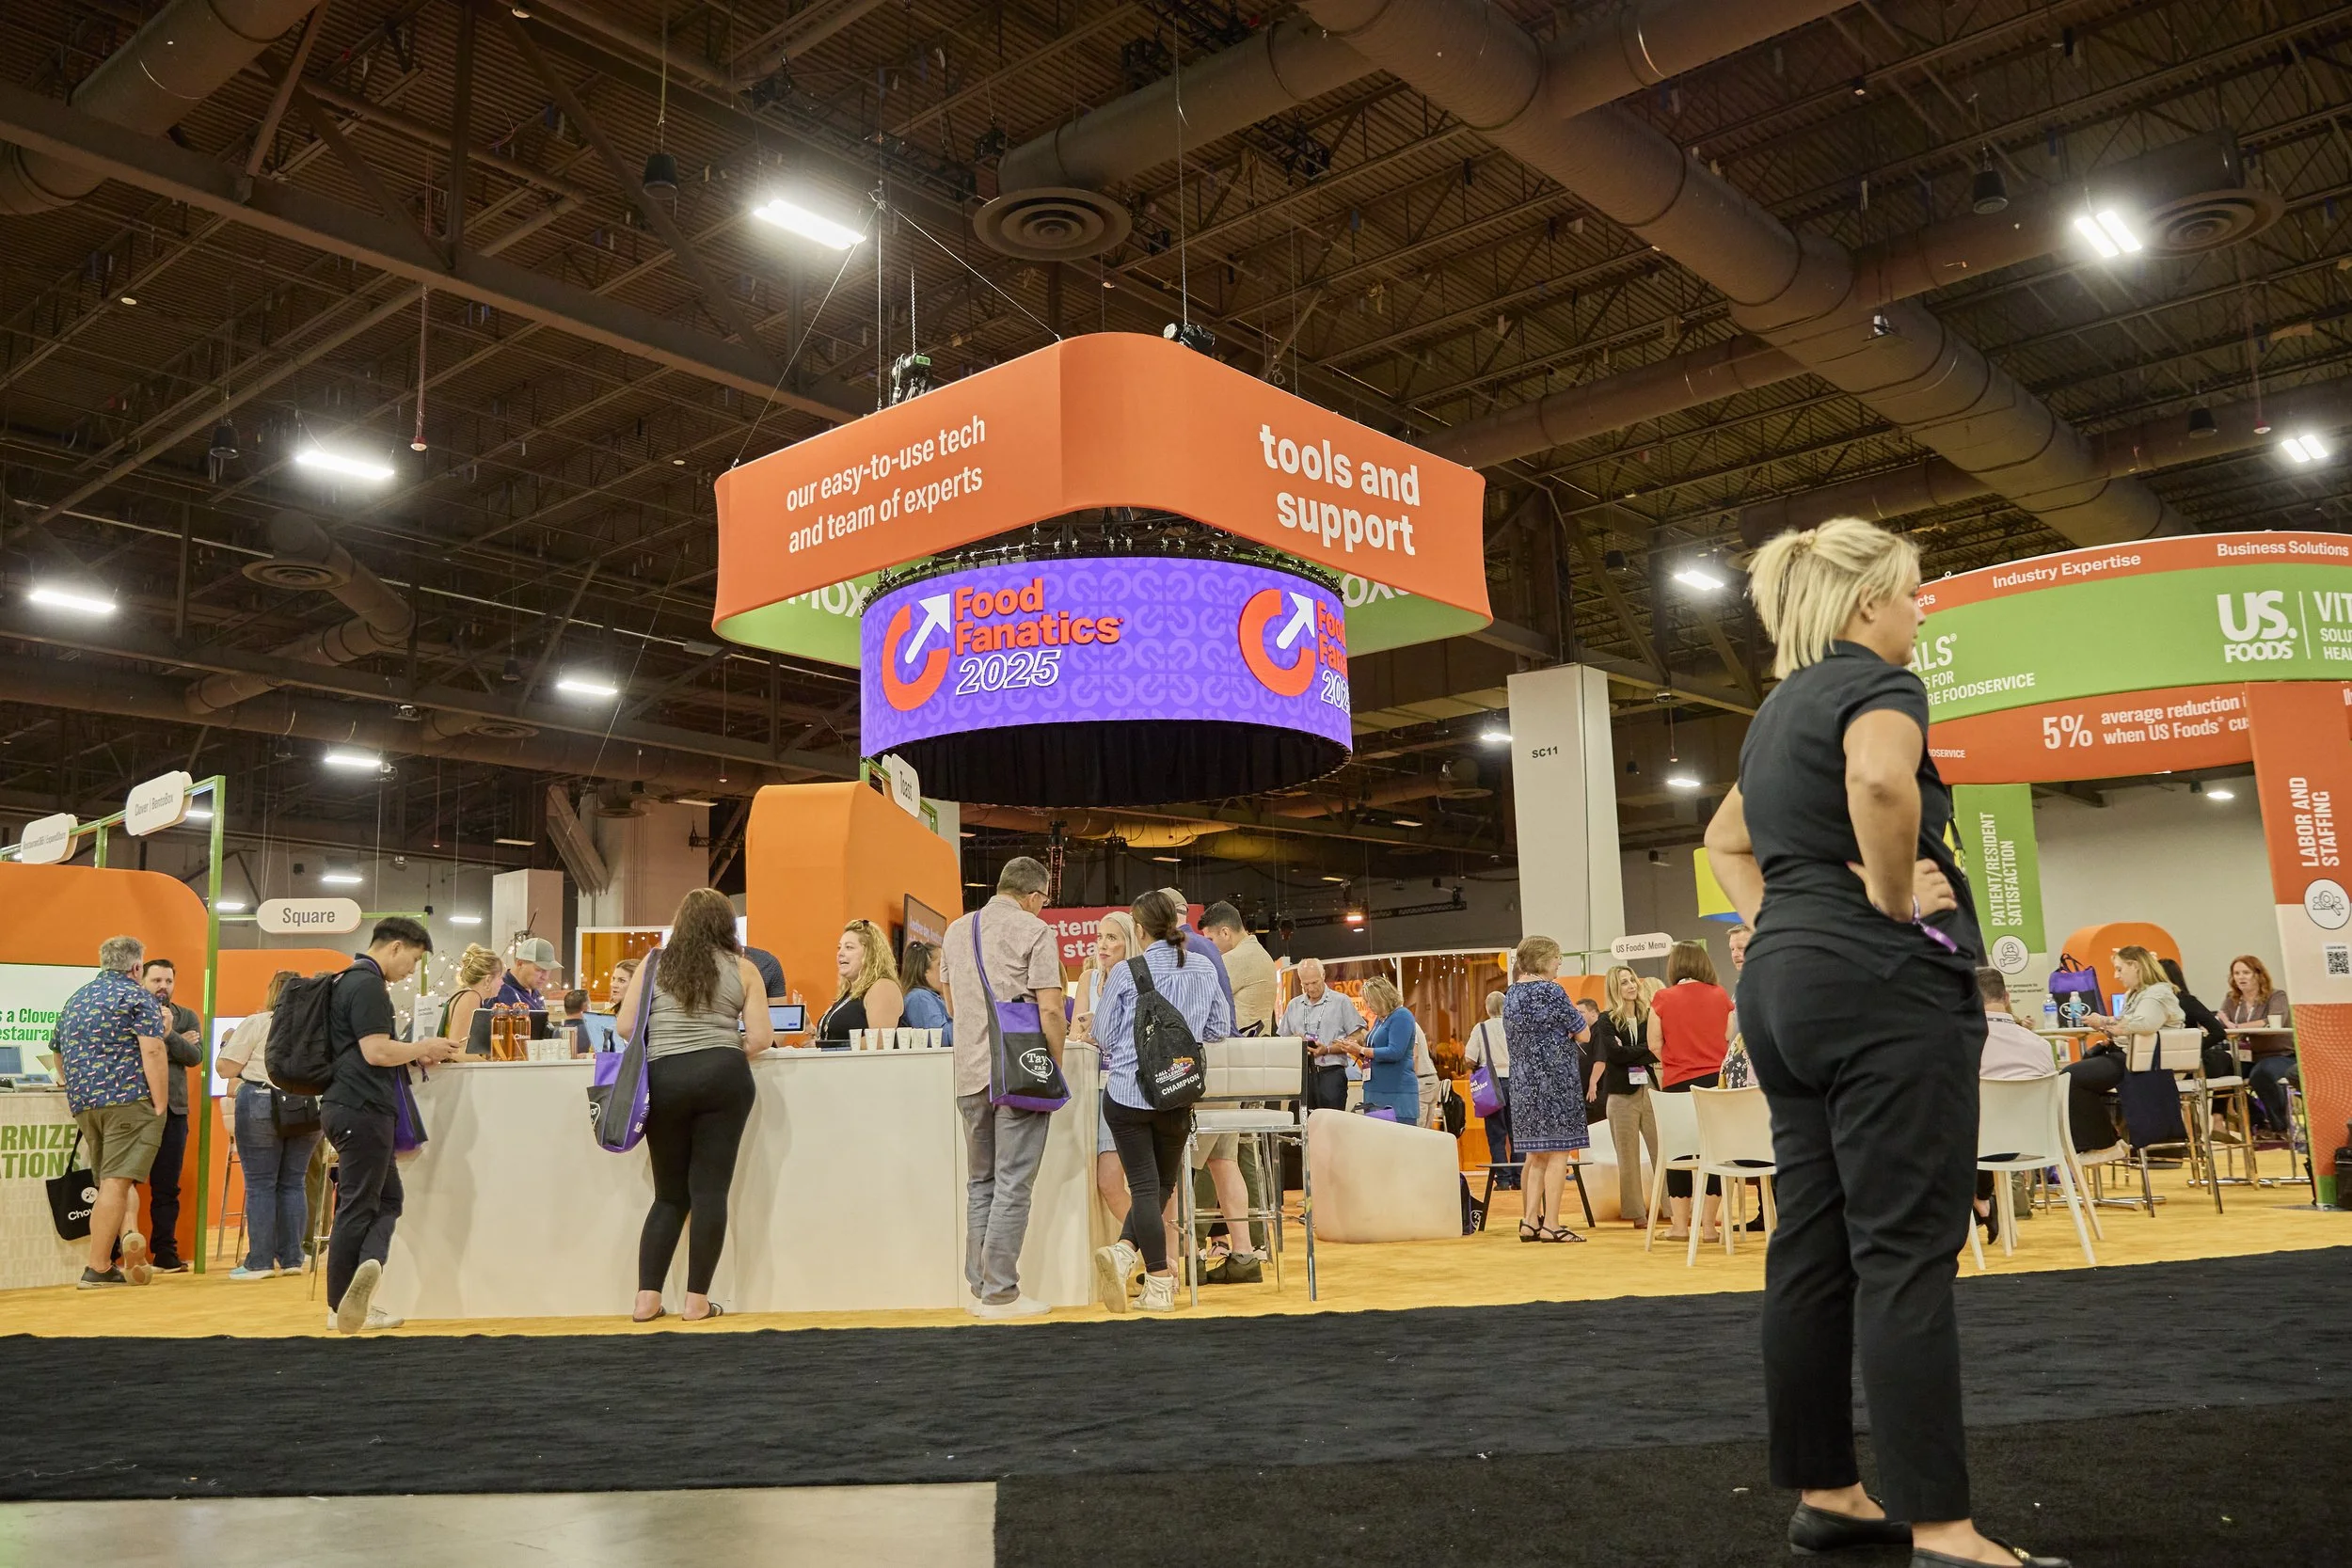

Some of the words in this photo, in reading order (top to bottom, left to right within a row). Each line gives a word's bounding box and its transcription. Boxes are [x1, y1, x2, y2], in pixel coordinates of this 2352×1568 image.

[787, 482, 817, 512] our
[820, 437, 934, 496] easy-to-use
[938, 415, 985, 456] tech
[1259, 423, 1354, 489] tools
[1360, 461, 1421, 507] and
[788, 515, 823, 554] and
[827, 503, 875, 540] team
[880, 487, 900, 522] of
[904, 466, 982, 515] experts
[1276, 492, 1416, 556] support
[2217, 542, 2286, 557] Business
[2288, 540, 2349, 557] Solutions
[1993, 567, 2058, 589] Industry
[2061, 554, 2141, 577] Expertise
[954, 578, 1044, 622] Food
[1341, 573, 1410, 608] OX
[1916, 594, 1936, 608] cts
[955, 649, 1062, 696] 2025
[1931, 670, 1954, 689] FOR
[1320, 669, 1351, 718] 202
[1943, 673, 2035, 704] FOODSERVICE
[2101, 705, 2165, 725] average
[2167, 693, 2240, 719] reduction
[2042, 713, 2093, 751] 5%
[2103, 727, 2145, 745] when
[2149, 722, 2169, 740] US
[1532, 746, 1559, 759] SC11
[900, 770, 913, 801] Toast
[2289, 776, 2312, 811] AND
[135, 801, 149, 816] Clover
[2294, 814, 2320, 867] LABOR
[2311, 791, 2341, 867] STAFFING
[1979, 812, 2007, 927] PATIENT/RESIDENT
[1999, 840, 2023, 927] SATISFACTION
[282, 908, 335, 927] Square
[1615, 944, 1625, 953] US
[1648, 941, 1666, 950] Menu
[7, 1010, 14, 1022] a
[0, 1026, 56, 1041] staura
[1027, 1053, 1048, 1066] Tay
[1161, 1072, 1200, 1096] CHAMPION
[0, 1124, 78, 1150] RNIZE
[0, 1152, 81, 1179] TIONS
[68, 1207, 93, 1222] Cho
